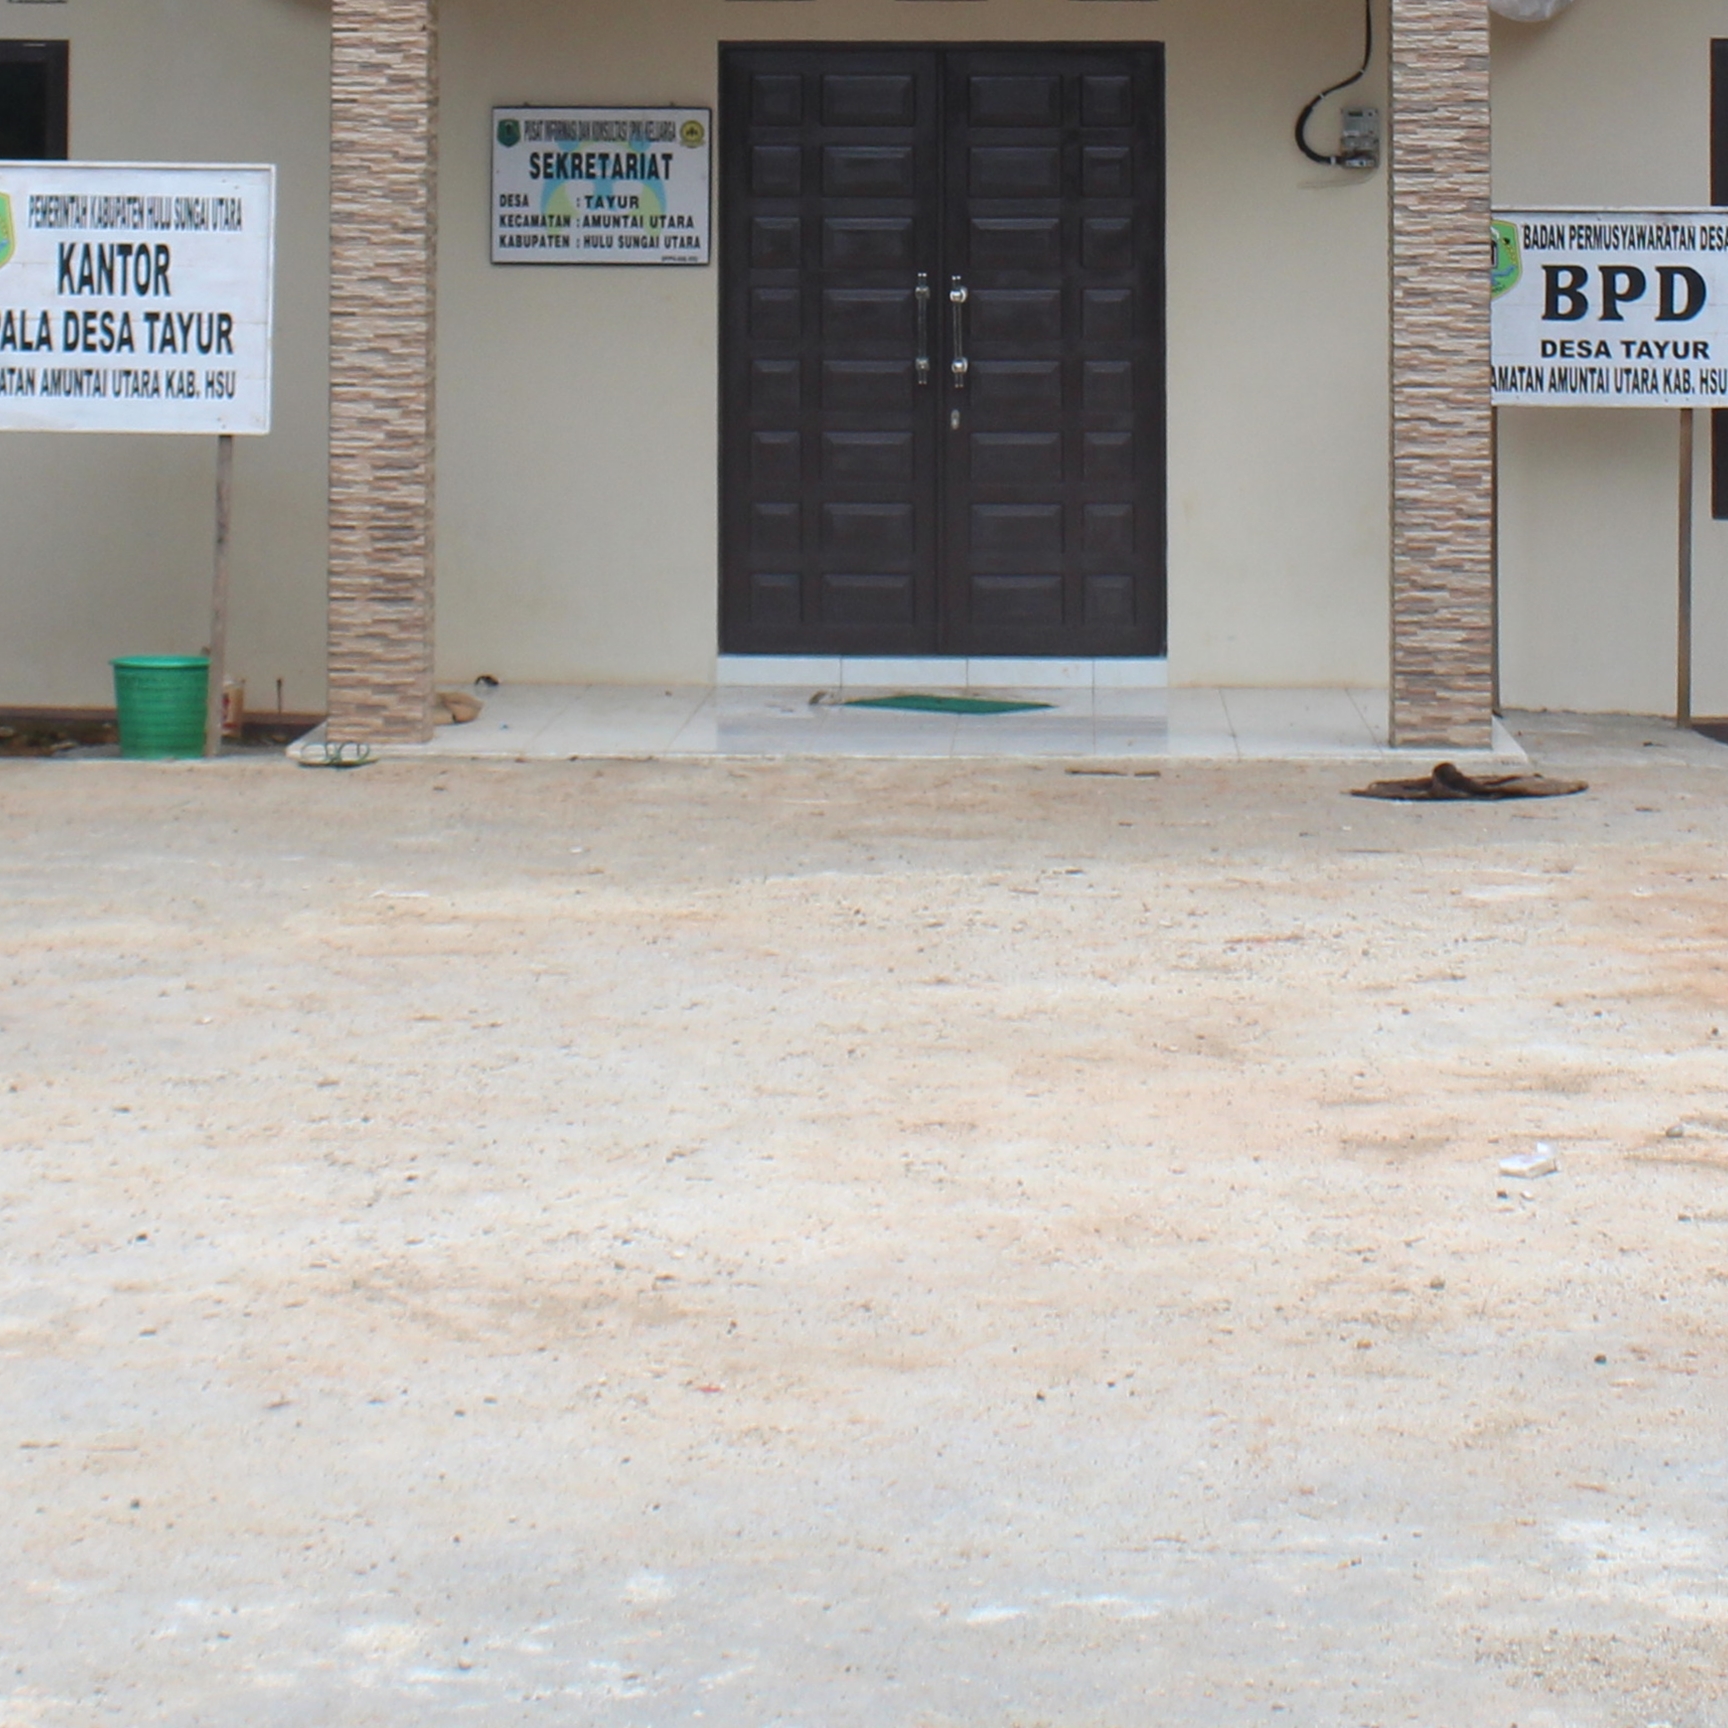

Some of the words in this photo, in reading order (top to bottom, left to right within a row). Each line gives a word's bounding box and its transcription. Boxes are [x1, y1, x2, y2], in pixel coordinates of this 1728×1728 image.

[529, 152, 674, 180] SEKRETARIAT
[29, 194, 88, 229] PEMERINTAH
[90, 195, 145, 230] KABUPATEN
[147, 196, 172, 230] HULU
[174, 196, 210, 231] SUNGAI
[212, 197, 242, 231] UTARA
[499, 194, 530, 208] DESA
[585, 195, 640, 209] TAYUR
[499, 215, 571, 228] KECAMATAN
[582, 216, 645, 229] AMUNTAI
[650, 216, 695, 229] UTARA
[499, 235, 570, 249] KABUPATEN
[584, 236, 613, 249] HULU
[618, 236, 660, 249] SUNGAI
[664, 236, 701, 249] UTARA
[1523, 224, 1565, 251] BADAN
[1569, 225, 1697, 251] PERMUSYAWARATAN
[57, 242, 172, 297] KANTOR
[1541, 264, 1707, 321] BPD
[62, 310, 135, 353] DESA
[143, 312, 234, 355] TAYUR
[1540, 339, 1612, 359] DESA
[1620, 340, 1711, 360] TAYUR
[40, 368, 108, 398] AMUNTAI
[112, 369, 161, 399] UTARA
[165, 370, 201, 399] KAB.
[205, 370, 237, 400] HSU
[1548, 367, 1610, 394] AMUNTAI
[1614, 368, 1659, 394] UTARA
[1663, 368, 1695, 394] KAB.
[1700, 368, 1728, 395] HSU
